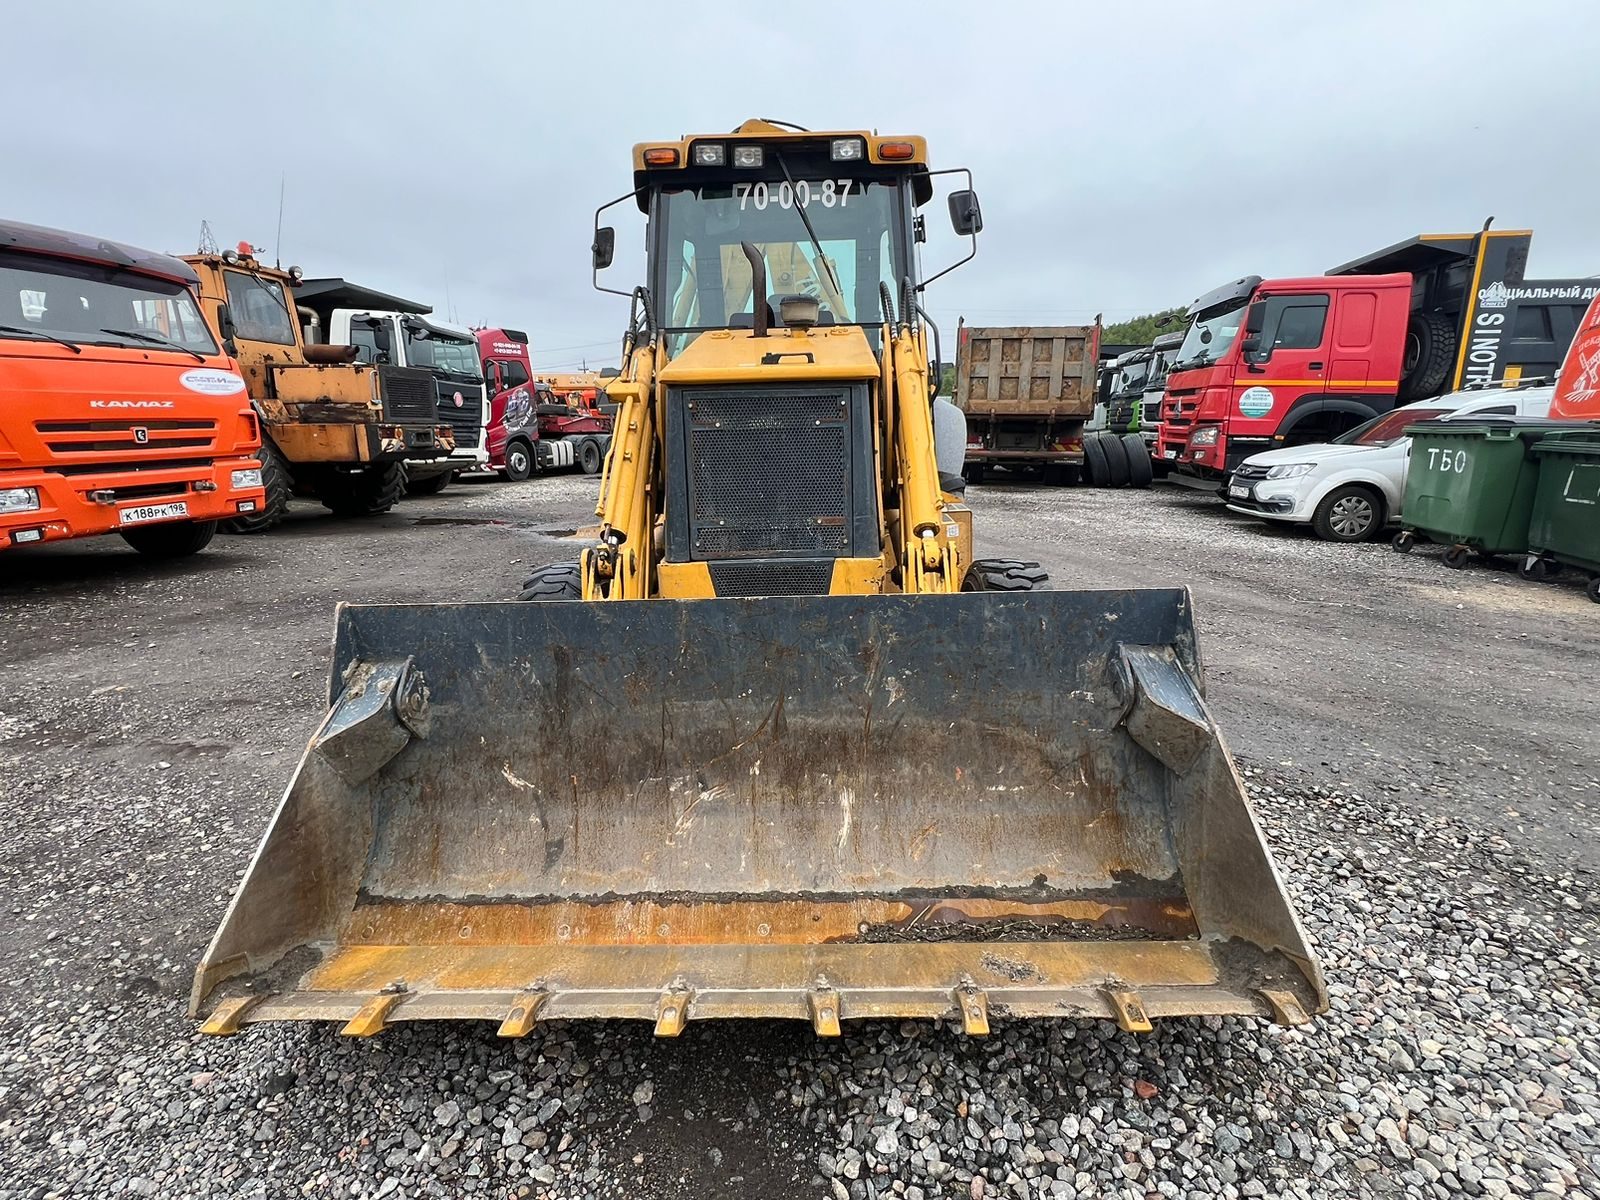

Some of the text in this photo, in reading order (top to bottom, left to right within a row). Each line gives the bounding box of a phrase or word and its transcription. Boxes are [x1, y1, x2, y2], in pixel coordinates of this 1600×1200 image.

[737, 179, 853, 211] 70-00-87
[1478, 285, 1581, 300] ОЦИАЛЬНЫЙ
[90, 400, 174, 408] KAMAZ
[1428, 448, 1466, 473] ТБО
[168, 503, 185, 513] 198
